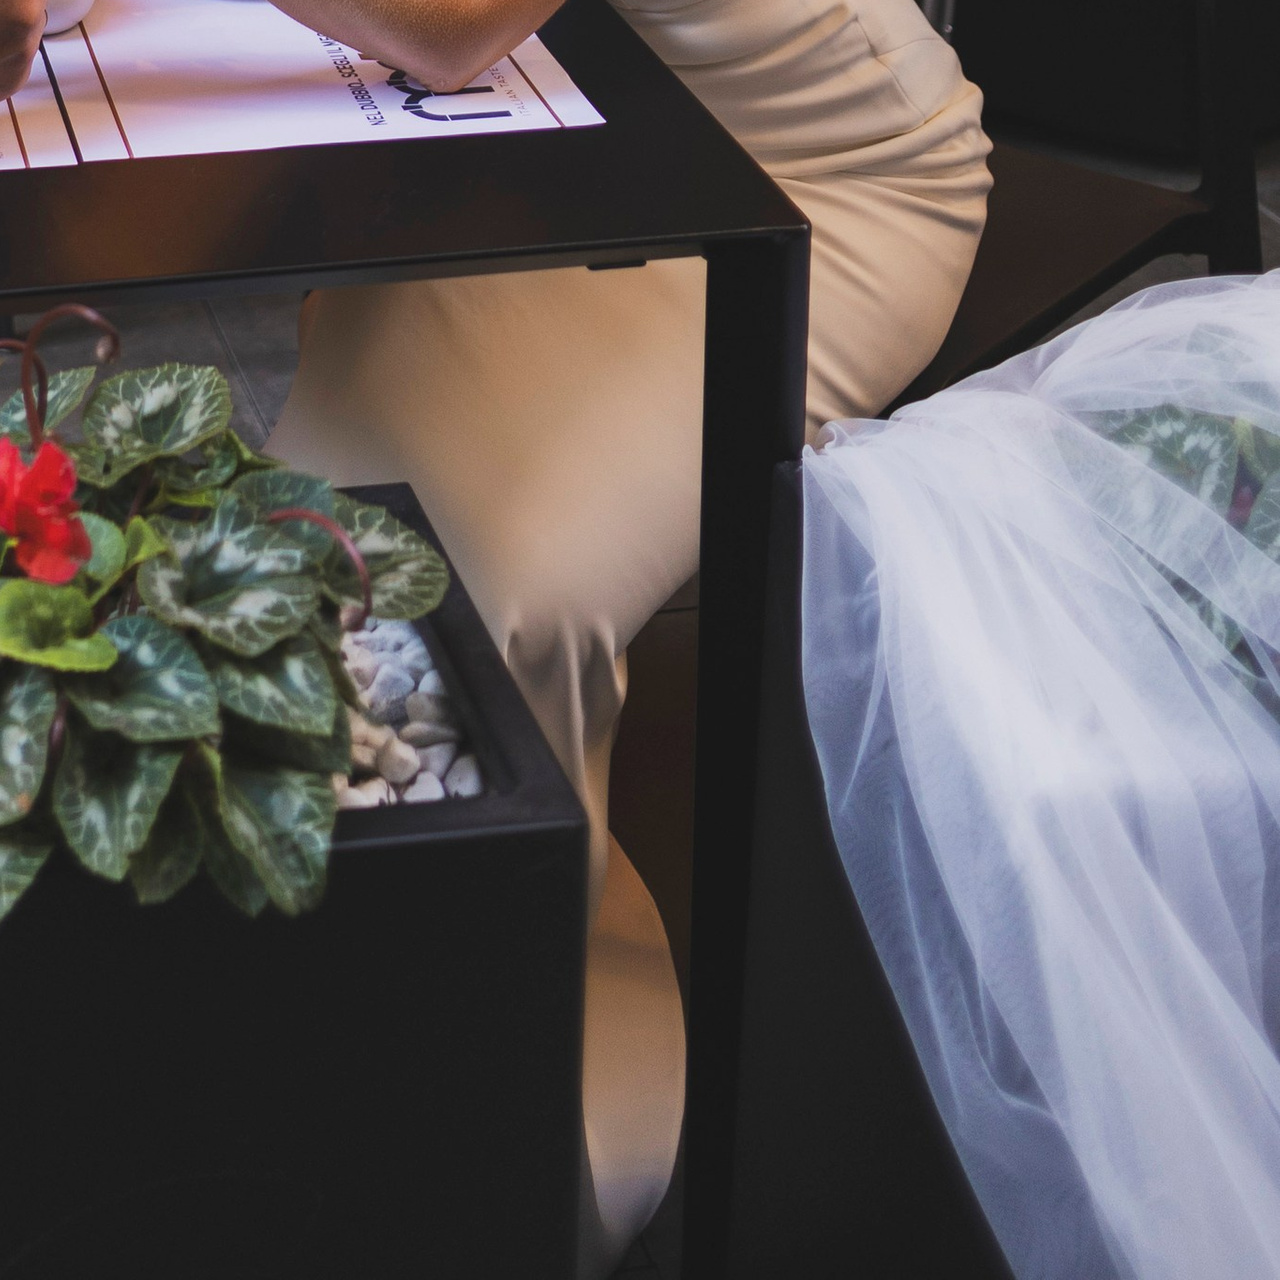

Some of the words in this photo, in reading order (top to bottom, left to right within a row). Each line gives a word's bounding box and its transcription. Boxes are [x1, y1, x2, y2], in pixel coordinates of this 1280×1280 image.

[329, 54, 358, 78] SCEGLI
[488, 67, 508, 88] TASTE
[504, 89, 532, 117] ITALIAN
[365, 110, 388, 126] NEL
